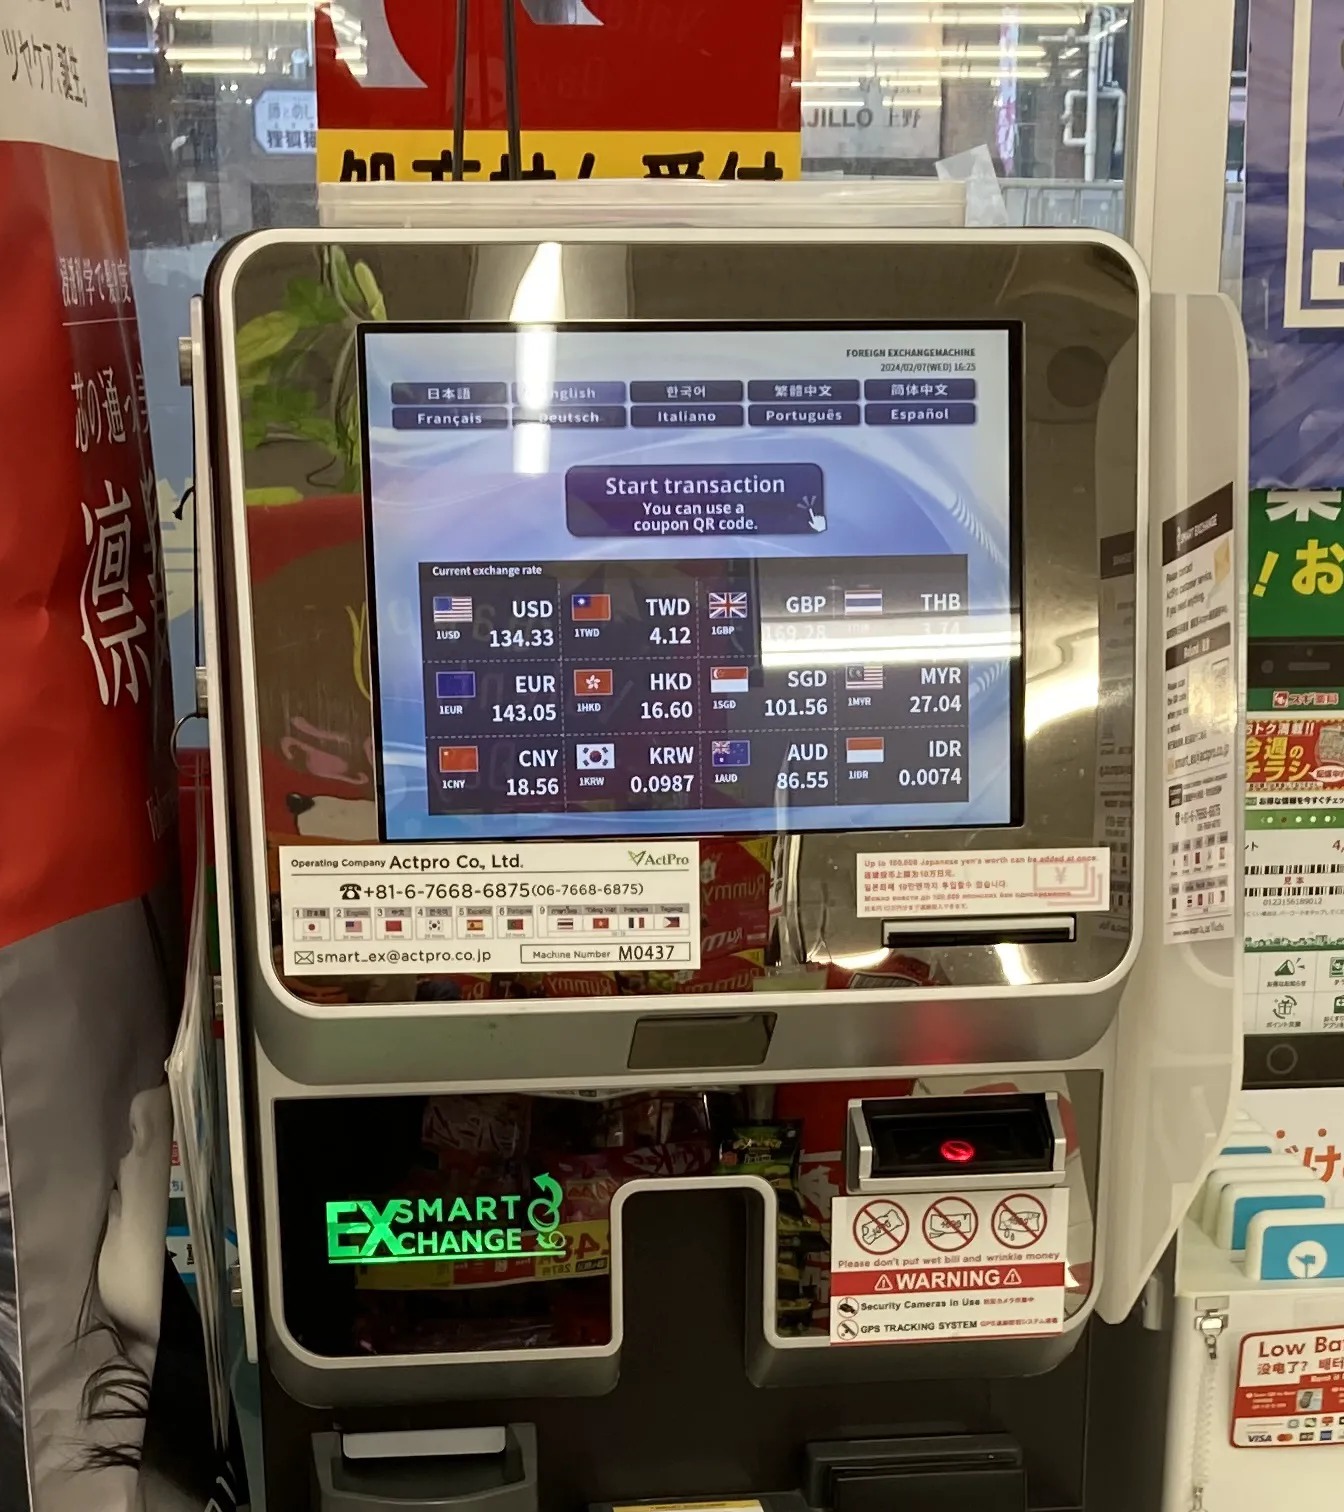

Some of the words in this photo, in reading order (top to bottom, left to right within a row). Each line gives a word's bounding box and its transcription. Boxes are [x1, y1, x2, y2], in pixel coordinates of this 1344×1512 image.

[846, 349, 886, 358] FOREIGN
[888, 348, 976, 357] EXCHANGEMACHINE
[427, 387, 471, 400] 日本語
[542, 386, 596, 402] nglish
[666, 385, 706, 398] 한국어
[774, 384, 832, 397] 繁體中文
[891, 384, 948, 396] 简体中文
[417, 412, 482, 425] Français
[539, 411, 599, 423] Deutsch
[657, 410, 716, 422] Italiano
[766, 409, 842, 423] Português
[891, 408, 949, 421] Español
[606, 477, 658, 495] Start
[664, 475, 785, 494] transaction
[643, 502, 672, 516] You
[675, 505, 702, 515] can
[706, 504, 731, 515] use
[735, 504, 744, 514] a
[634, 519, 689, 533] coupon
[692, 518, 715, 533] QR
[719, 517, 758, 530] code.
[432, 566, 471, 576] Current
[473, 566, 520, 577] exchange
[522, 566, 542, 575] rate
[512, 601, 553, 618] USD
[646, 598, 690, 616] TWD
[786, 596, 826, 613] GBP
[921, 593, 960, 611] THB
[489, 629, 554, 648] 134.33
[650, 627, 691, 645] 4.12
[650, 673, 692, 691] HKD
[788, 670, 827, 688] SGD
[921, 667, 961, 684] MYR
[515, 676, 555, 693] EUR
[641, 702, 693, 719] 16.60
[764, 698, 828, 716] 101.56
[909, 695, 962, 713] 27.04
[492, 704, 556, 722] 143.05
[649, 747, 694, 765] KRW
[787, 743, 828, 761] AUD
[929, 740, 961, 757] IDR
[518, 750, 558, 767] CNY
[630, 775, 694, 793] 0.0987
[776, 771, 829, 789] 86.55
[899, 768, 962, 786] 0.0074
[506, 778, 559, 796] 18.56
[291, 858, 338, 870] Operating
[341, 858, 386, 869] Company
[389, 854, 450, 872] Actpro
[492, 853, 524, 869] Ltd.
[644, 854, 690, 866] ActPro
[864, 860, 876, 868] Up
[920, 858, 958, 868] Japanese
[984, 856, 1008, 864] worth
[316, 949, 492, 964] smart_ex@actpro.co.jp
[532, 950, 572, 960] Machine
[574, 949, 611, 959] Number
[618, 945, 675, 961] M0437
[326, 1201, 402, 1257] EX
[395, 1196, 520, 1223] SMART
[398, 1229, 522, 1254] CHANGE
[838, 1259, 871, 1269] Please
[873, 1257, 900, 1267] don't
[902, 1257, 919, 1267] put
[922, 1257, 942, 1265] wet
[944, 1254, 960, 1264] bill
[962, 1254, 982, 1263] and
[986, 1253, 1023, 1262] wrinkle
[1026, 1252, 1060, 1262] money
[896, 1269, 1000, 1290] WARNING
[861, 1301, 901, 1312] Security
[904, 1299, 946, 1310] Cameras
[962, 1298, 980, 1307] Use
[861, 1324, 880, 1334] GPS
[884, 1322, 935, 1332] TRACKING
[938, 1320, 977, 1329] SYSTEM
[1258, 1341, 1305, 1358] Low
[1248, 1434, 1272, 1442] VISA
